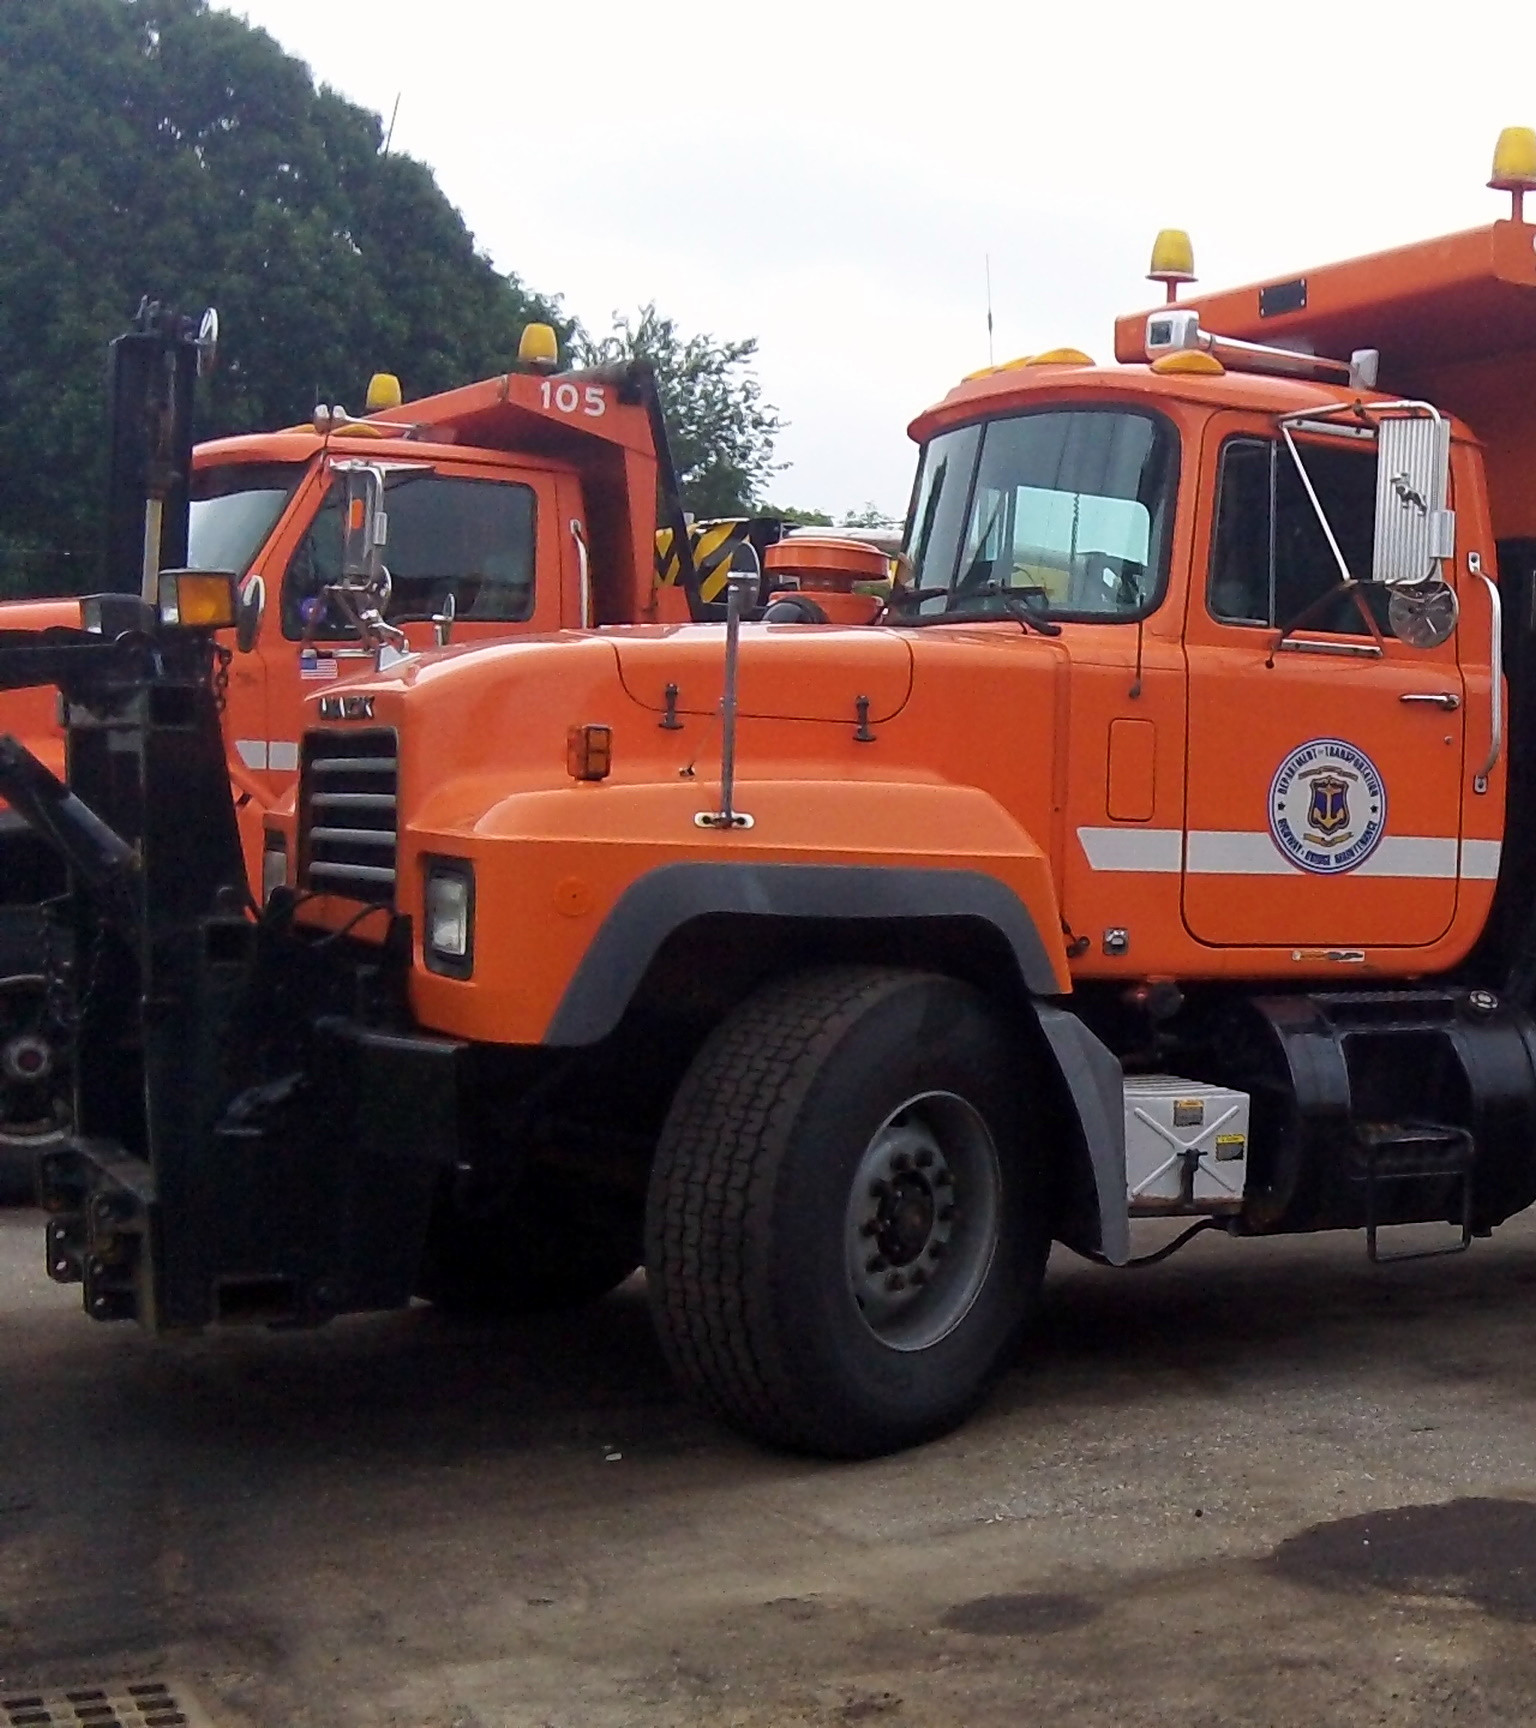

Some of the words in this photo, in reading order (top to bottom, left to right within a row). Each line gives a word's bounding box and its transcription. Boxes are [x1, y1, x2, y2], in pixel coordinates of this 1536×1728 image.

[540, 381, 606, 417] 105
[1277, 748, 1317, 795] DEPARTMENT
[1325, 746, 1379, 797] TRANSPORTATION
